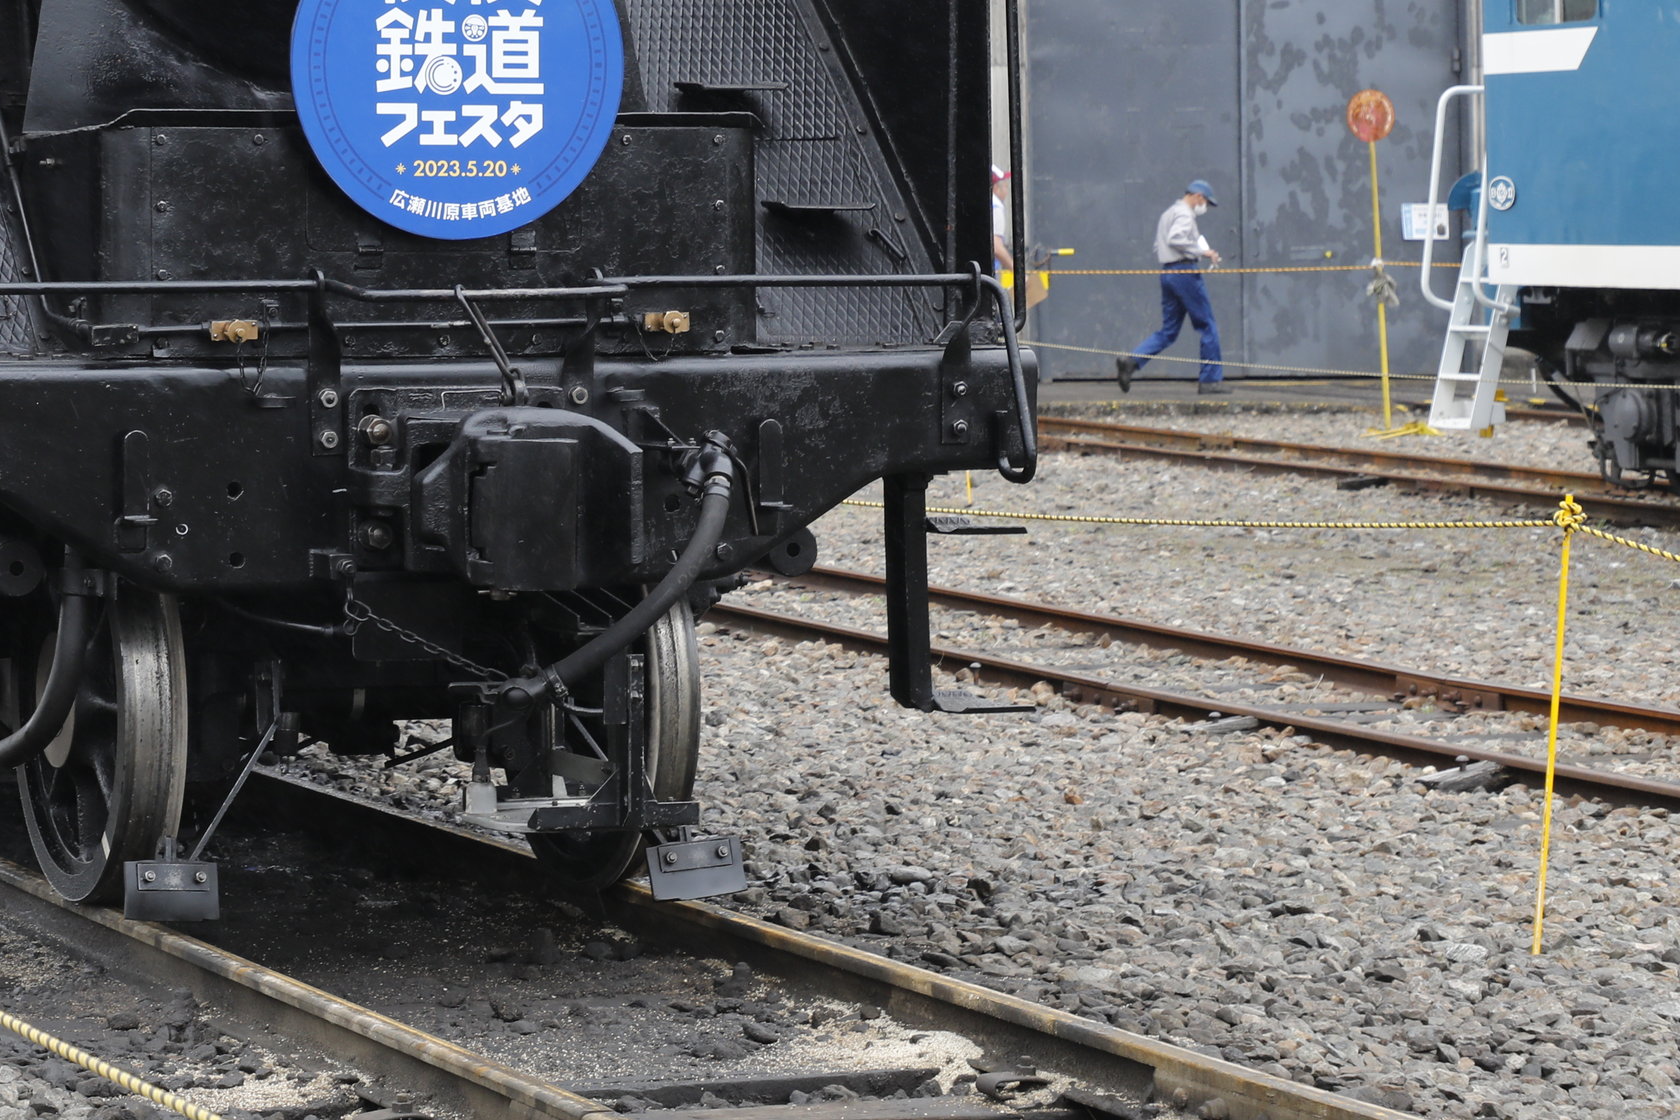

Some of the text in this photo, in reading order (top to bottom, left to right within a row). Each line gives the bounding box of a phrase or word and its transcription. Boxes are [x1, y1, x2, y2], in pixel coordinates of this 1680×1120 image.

[376, 6, 544, 96] 鉄道
[376, 100, 544, 149] フェスタ
[413, 160, 508, 177] 2023.5.20
[389, 186, 532, 221] 広瀬川原車両基地
